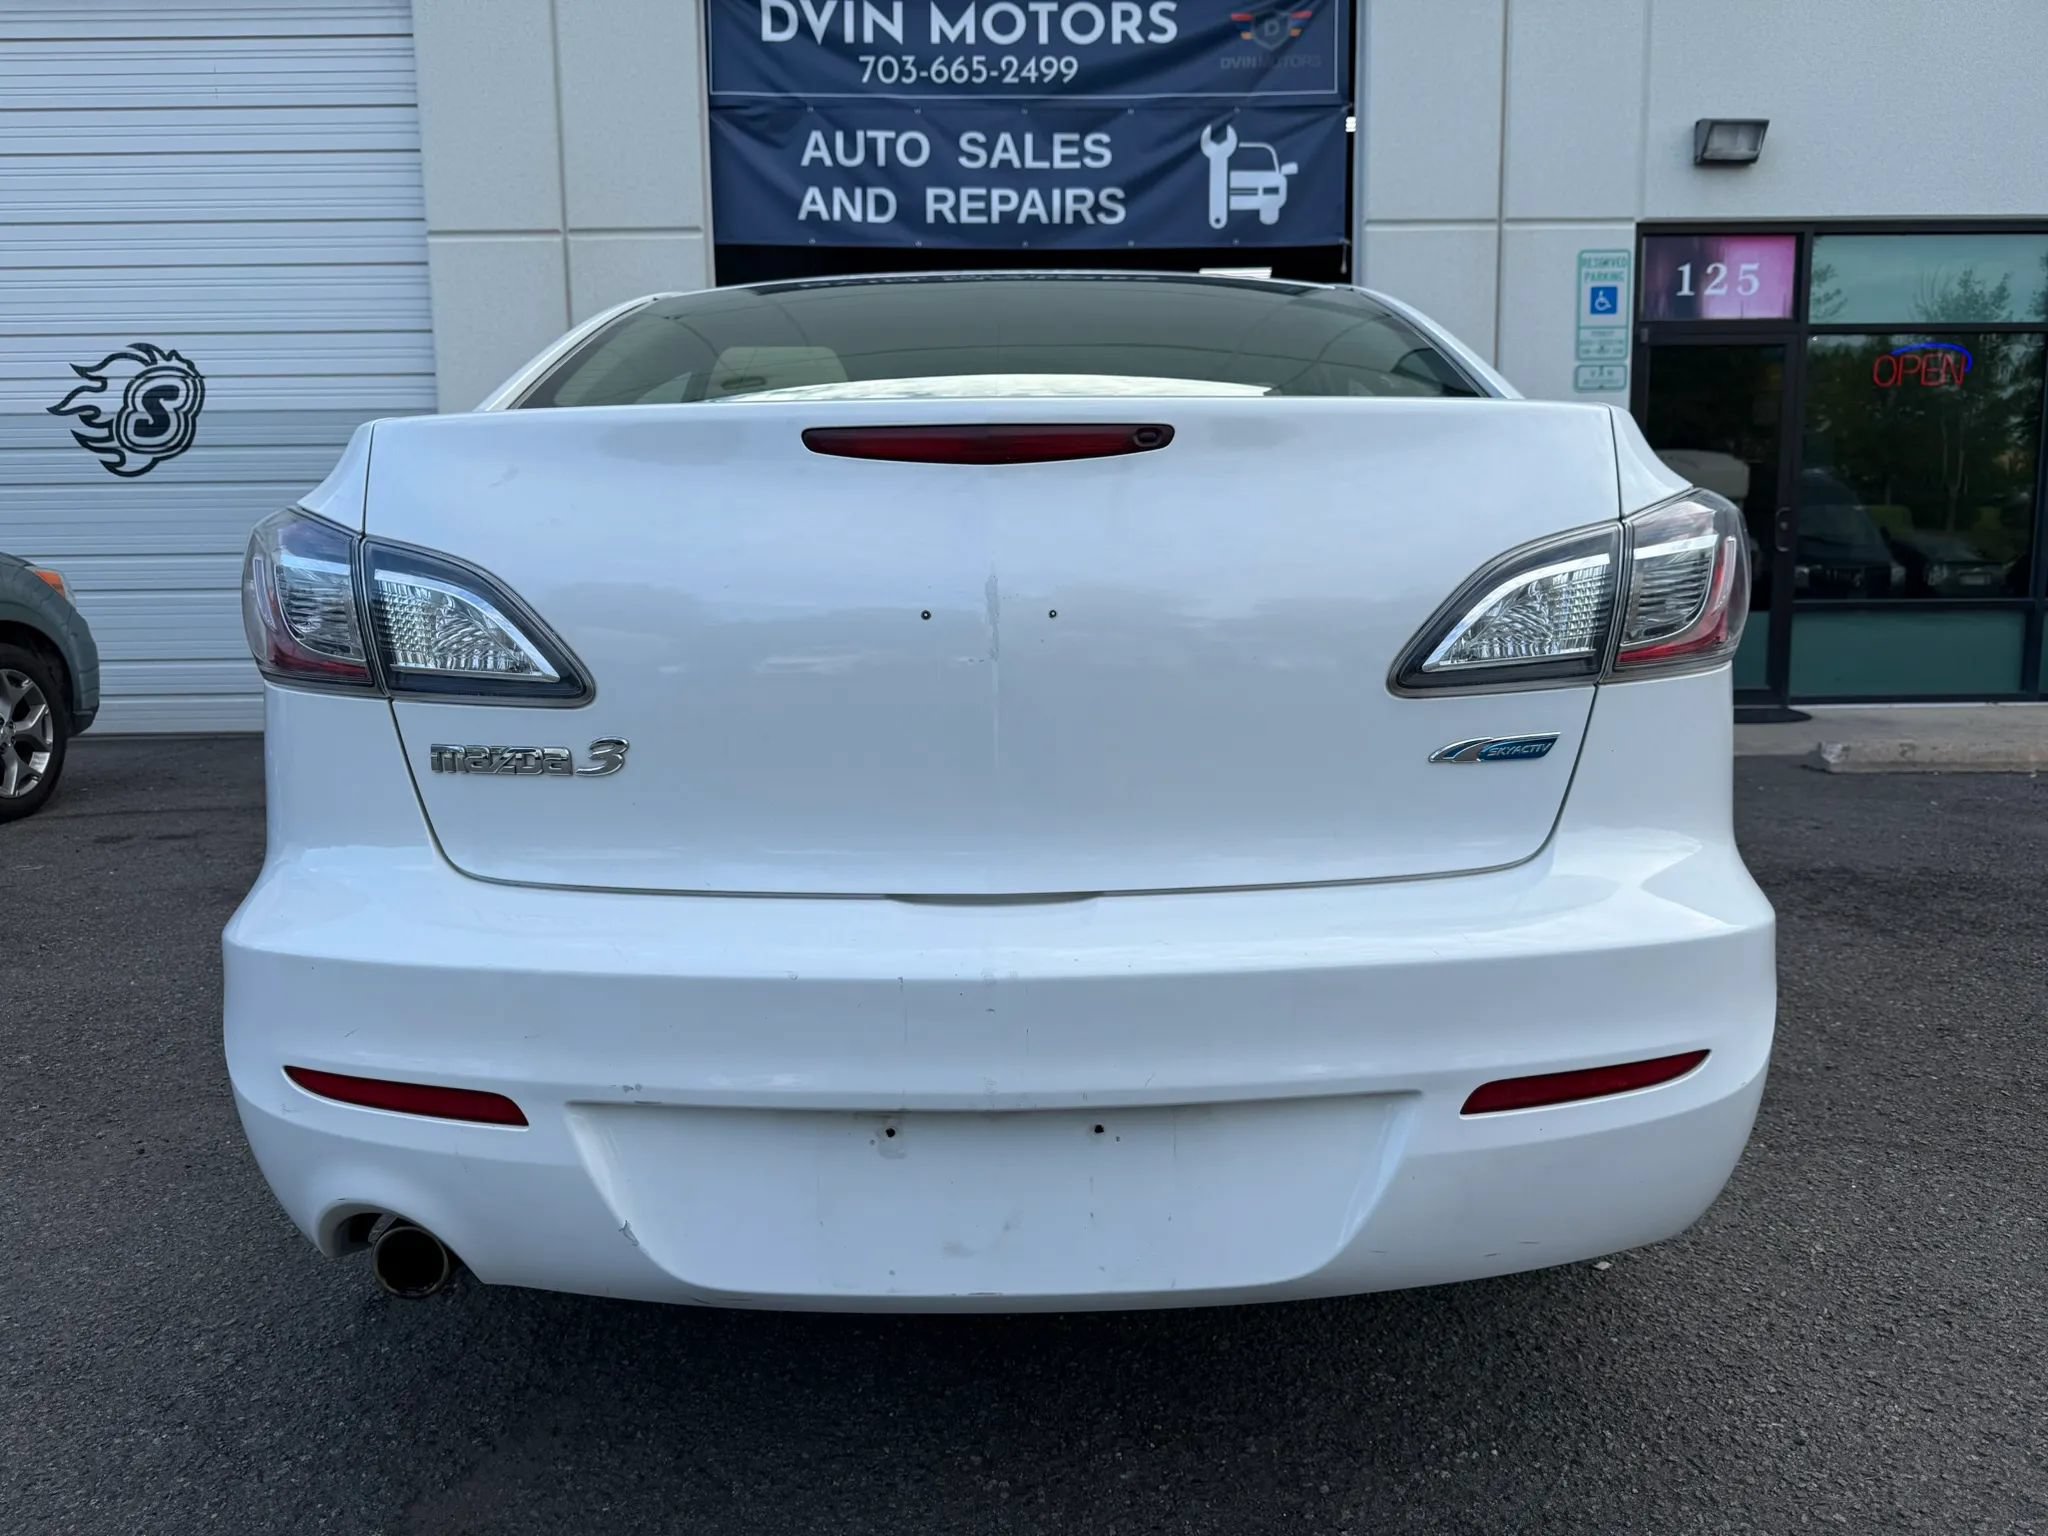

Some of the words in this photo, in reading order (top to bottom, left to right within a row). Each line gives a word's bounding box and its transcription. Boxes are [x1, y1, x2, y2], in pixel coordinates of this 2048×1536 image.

[760, 0, 904, 44] DVIN
[930, 0, 1178, 45] MOTORS
[858, 55, 1079, 84] 703-665-2499
[1220, 56, 1257, 69] DVIN
[1259, 55, 1322, 69] TORS
[800, 130, 931, 167] AUTO
[958, 131, 1112, 169] SALES
[798, 186, 898, 223] AND
[925, 187, 1127, 225] REPAIRS
[1873, 353, 1967, 388] OPEN
[1486, 742, 1552, 757] SKYACTIV
